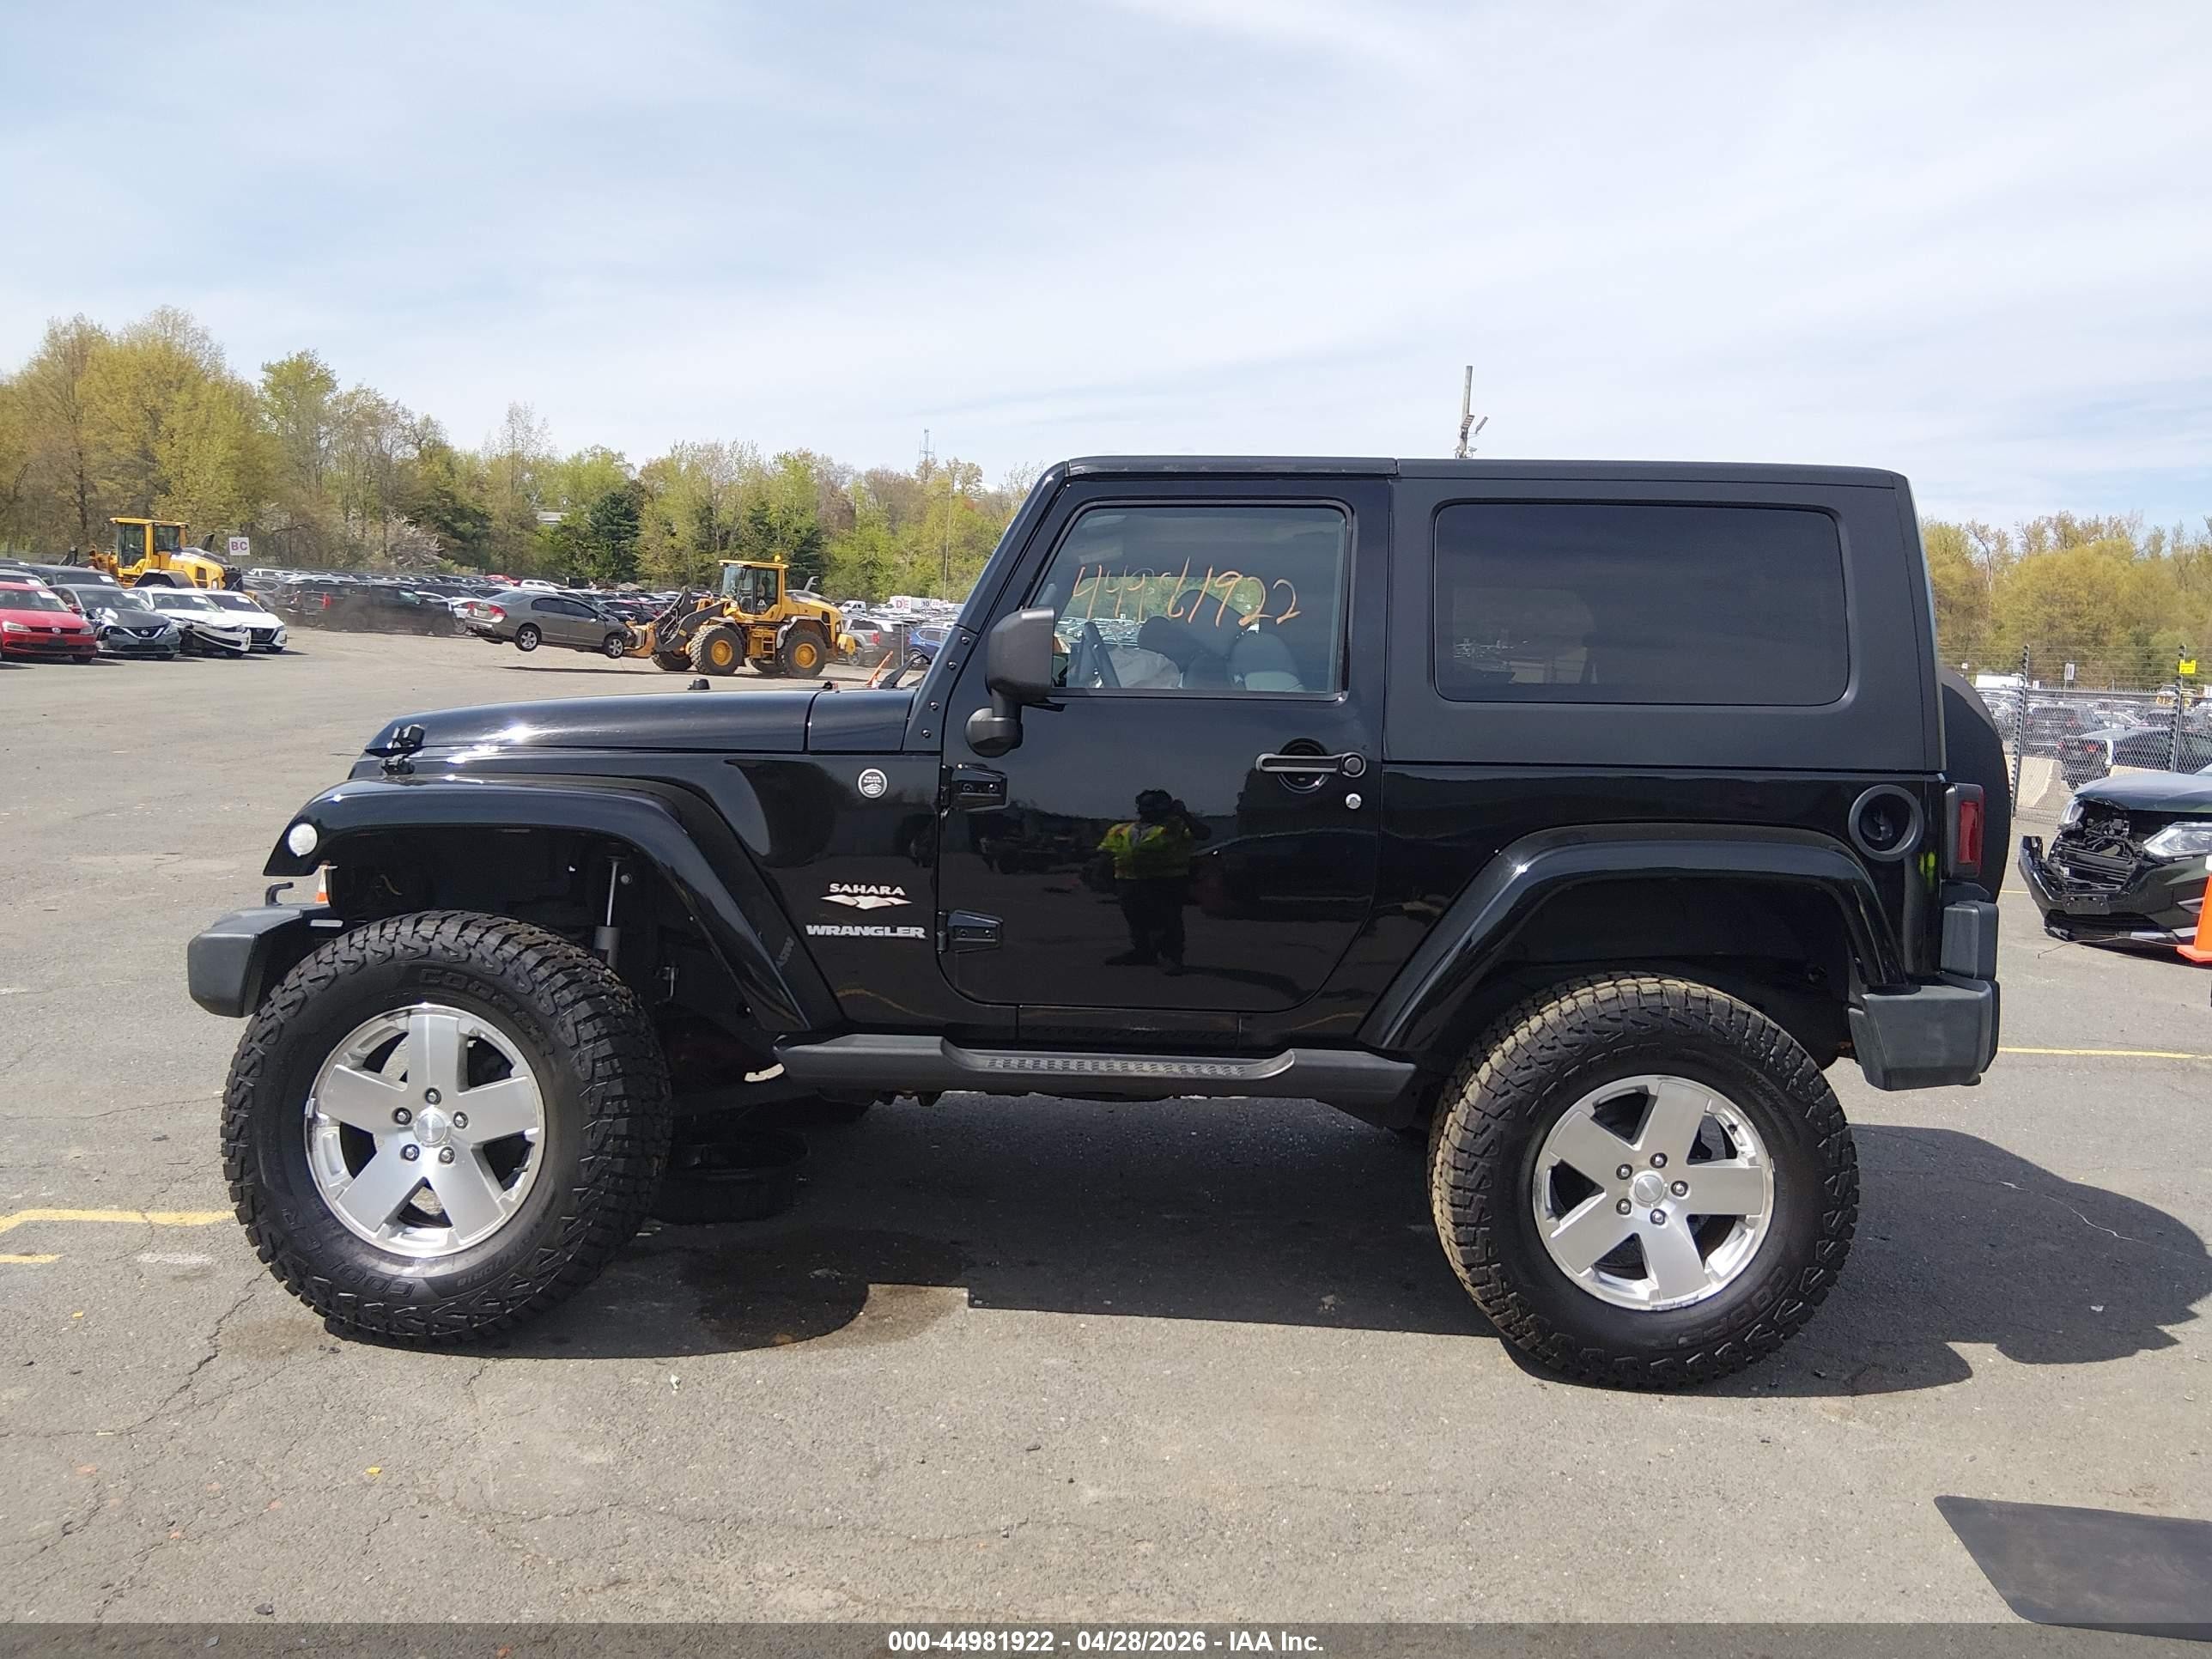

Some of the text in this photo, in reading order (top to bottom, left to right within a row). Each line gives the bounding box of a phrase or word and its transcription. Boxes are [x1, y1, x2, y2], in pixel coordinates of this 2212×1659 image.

[231, 541, 247, 550] BC
[896, 599, 909, 609] DE
[830, 883, 906, 896] SAHARA
[805, 924, 927, 939] WRANGLER
